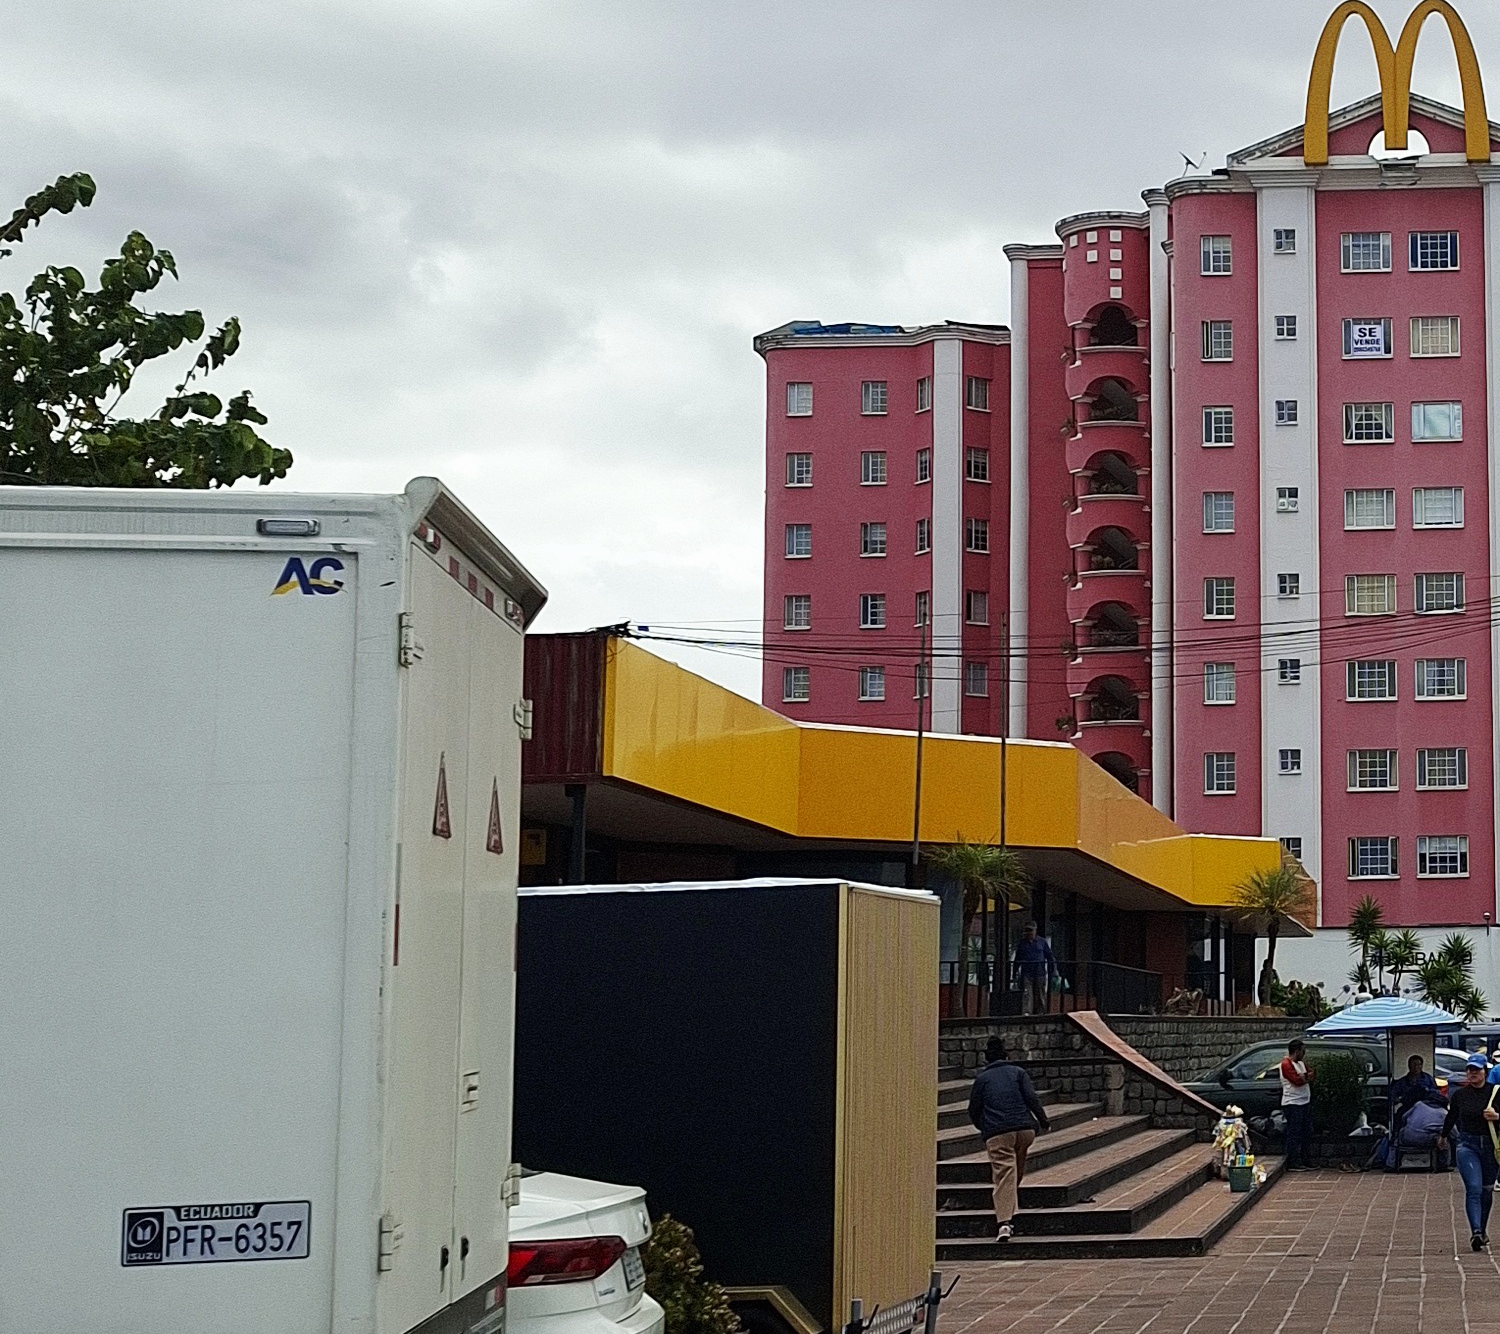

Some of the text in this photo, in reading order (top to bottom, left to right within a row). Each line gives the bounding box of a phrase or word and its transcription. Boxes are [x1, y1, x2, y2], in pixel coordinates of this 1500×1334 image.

[1358, 327, 1377, 338] SE
[270, 556, 346, 596] AC
[180, 1204, 255, 1220] ECUADOR
[165, 1220, 303, 1258] PFR-6357
[127, 1252, 161, 1261] ISUZU
